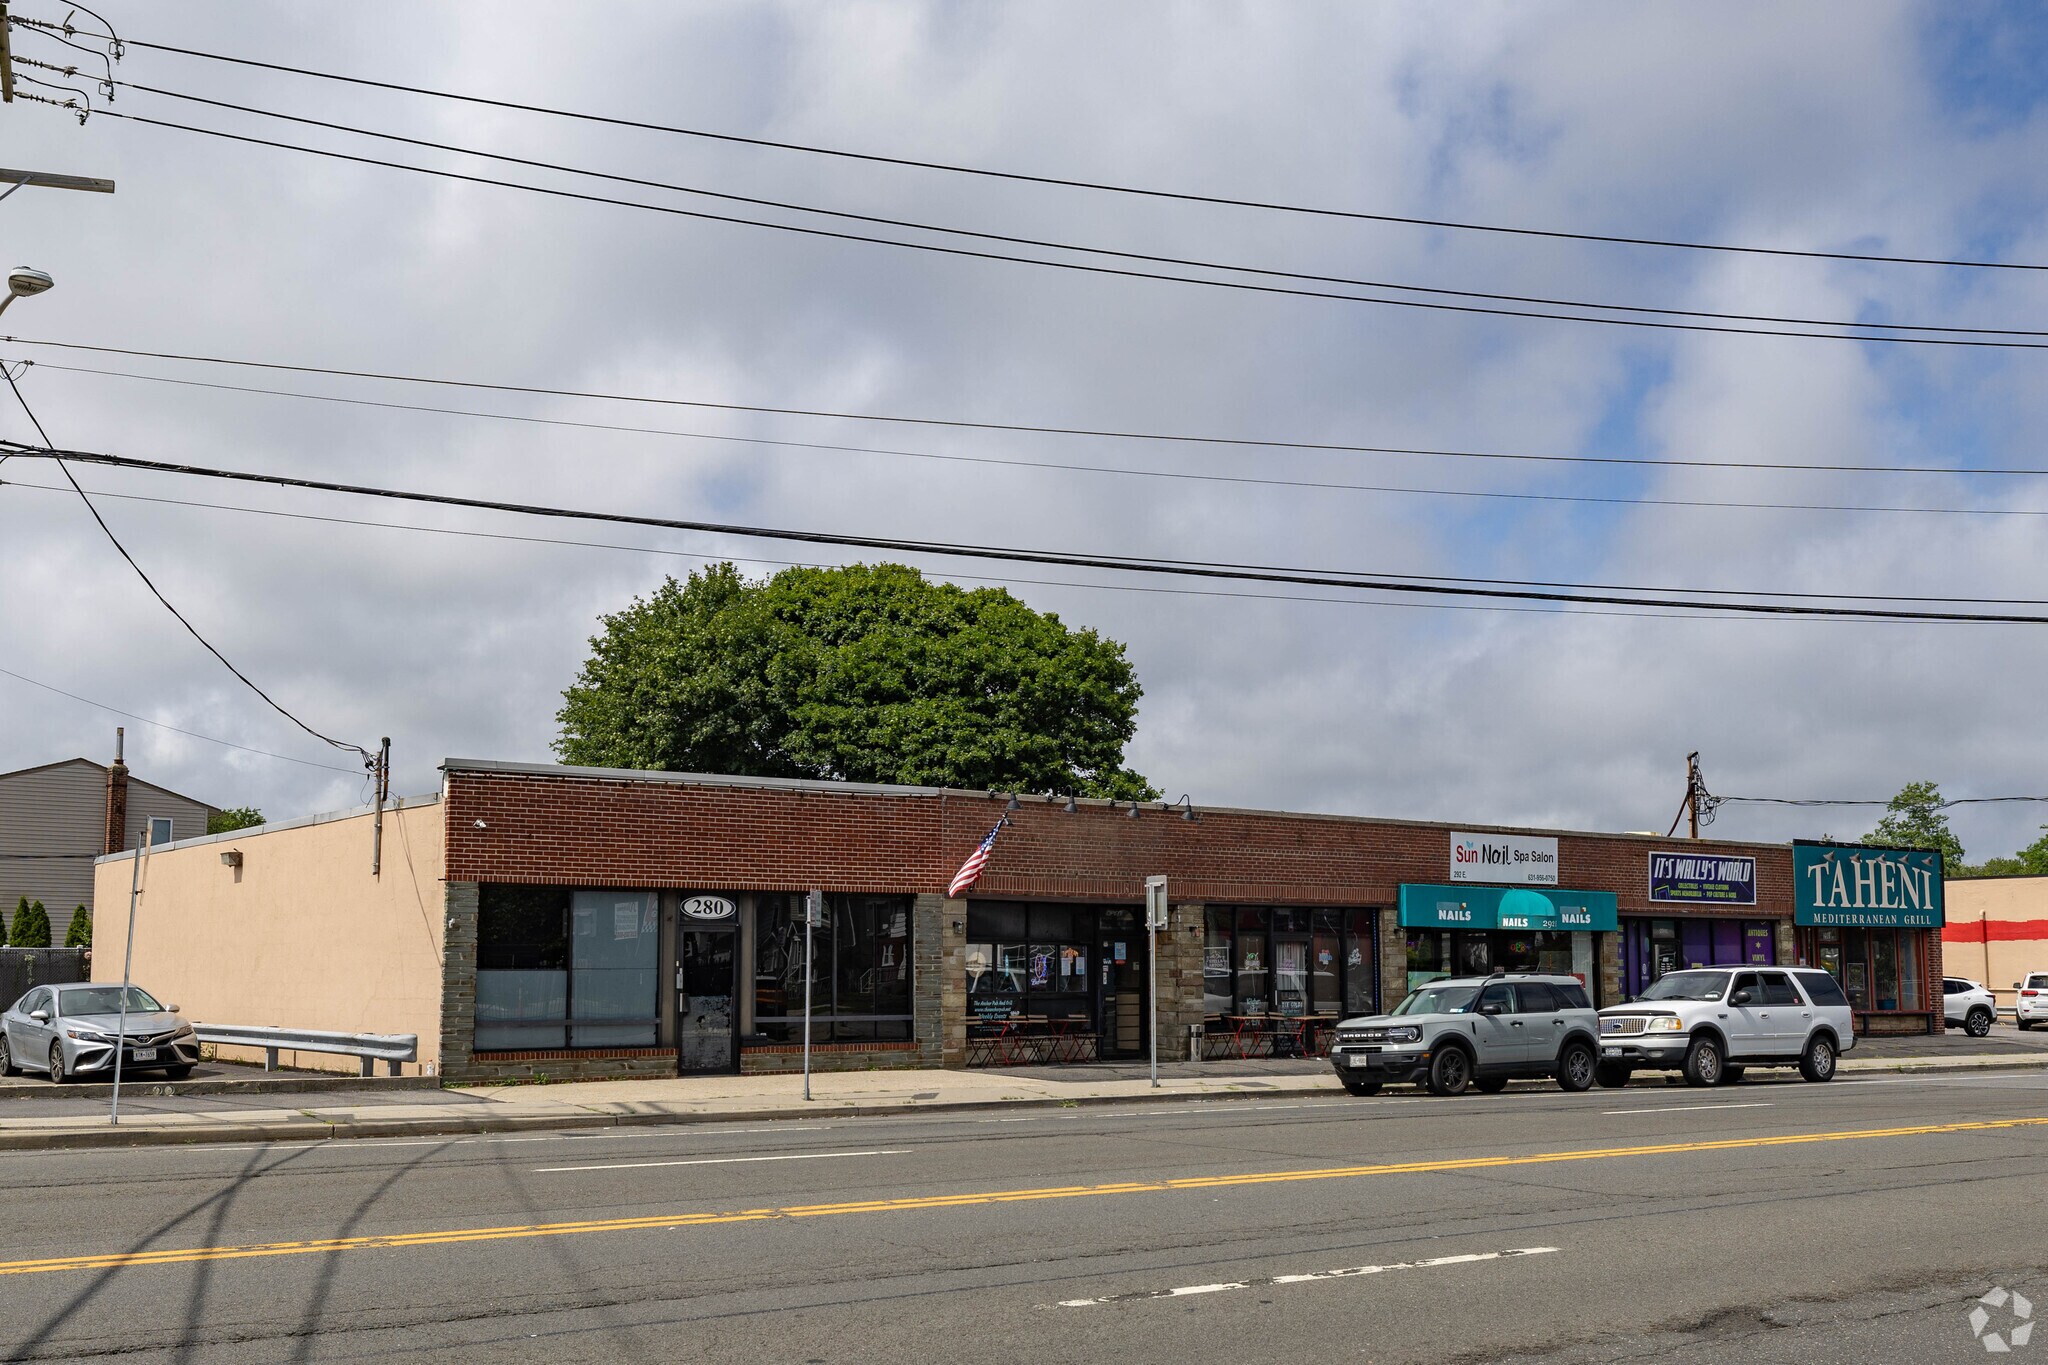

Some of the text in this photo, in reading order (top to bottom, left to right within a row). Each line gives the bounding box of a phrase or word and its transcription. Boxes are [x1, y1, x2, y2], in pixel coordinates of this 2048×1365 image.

[1456, 843, 1554, 865] Sun Nail Spa Salon
[1654, 857, 1751, 882] IT'S WALLY'S WORLD
[1807, 859, 1934, 910] TAHENI
[692, 899, 724, 915] 280
[1438, 909, 1472, 921] NAILS
[1562, 913, 1591, 924] NAILS
[1813, 913, 1931, 925] MEDITERRANEAN GRILL
[1502, 917, 1528, 928] NAILS
[1748, 929, 1769, 937] ANTIQUES
[1752, 954, 1766, 962] VINYL
